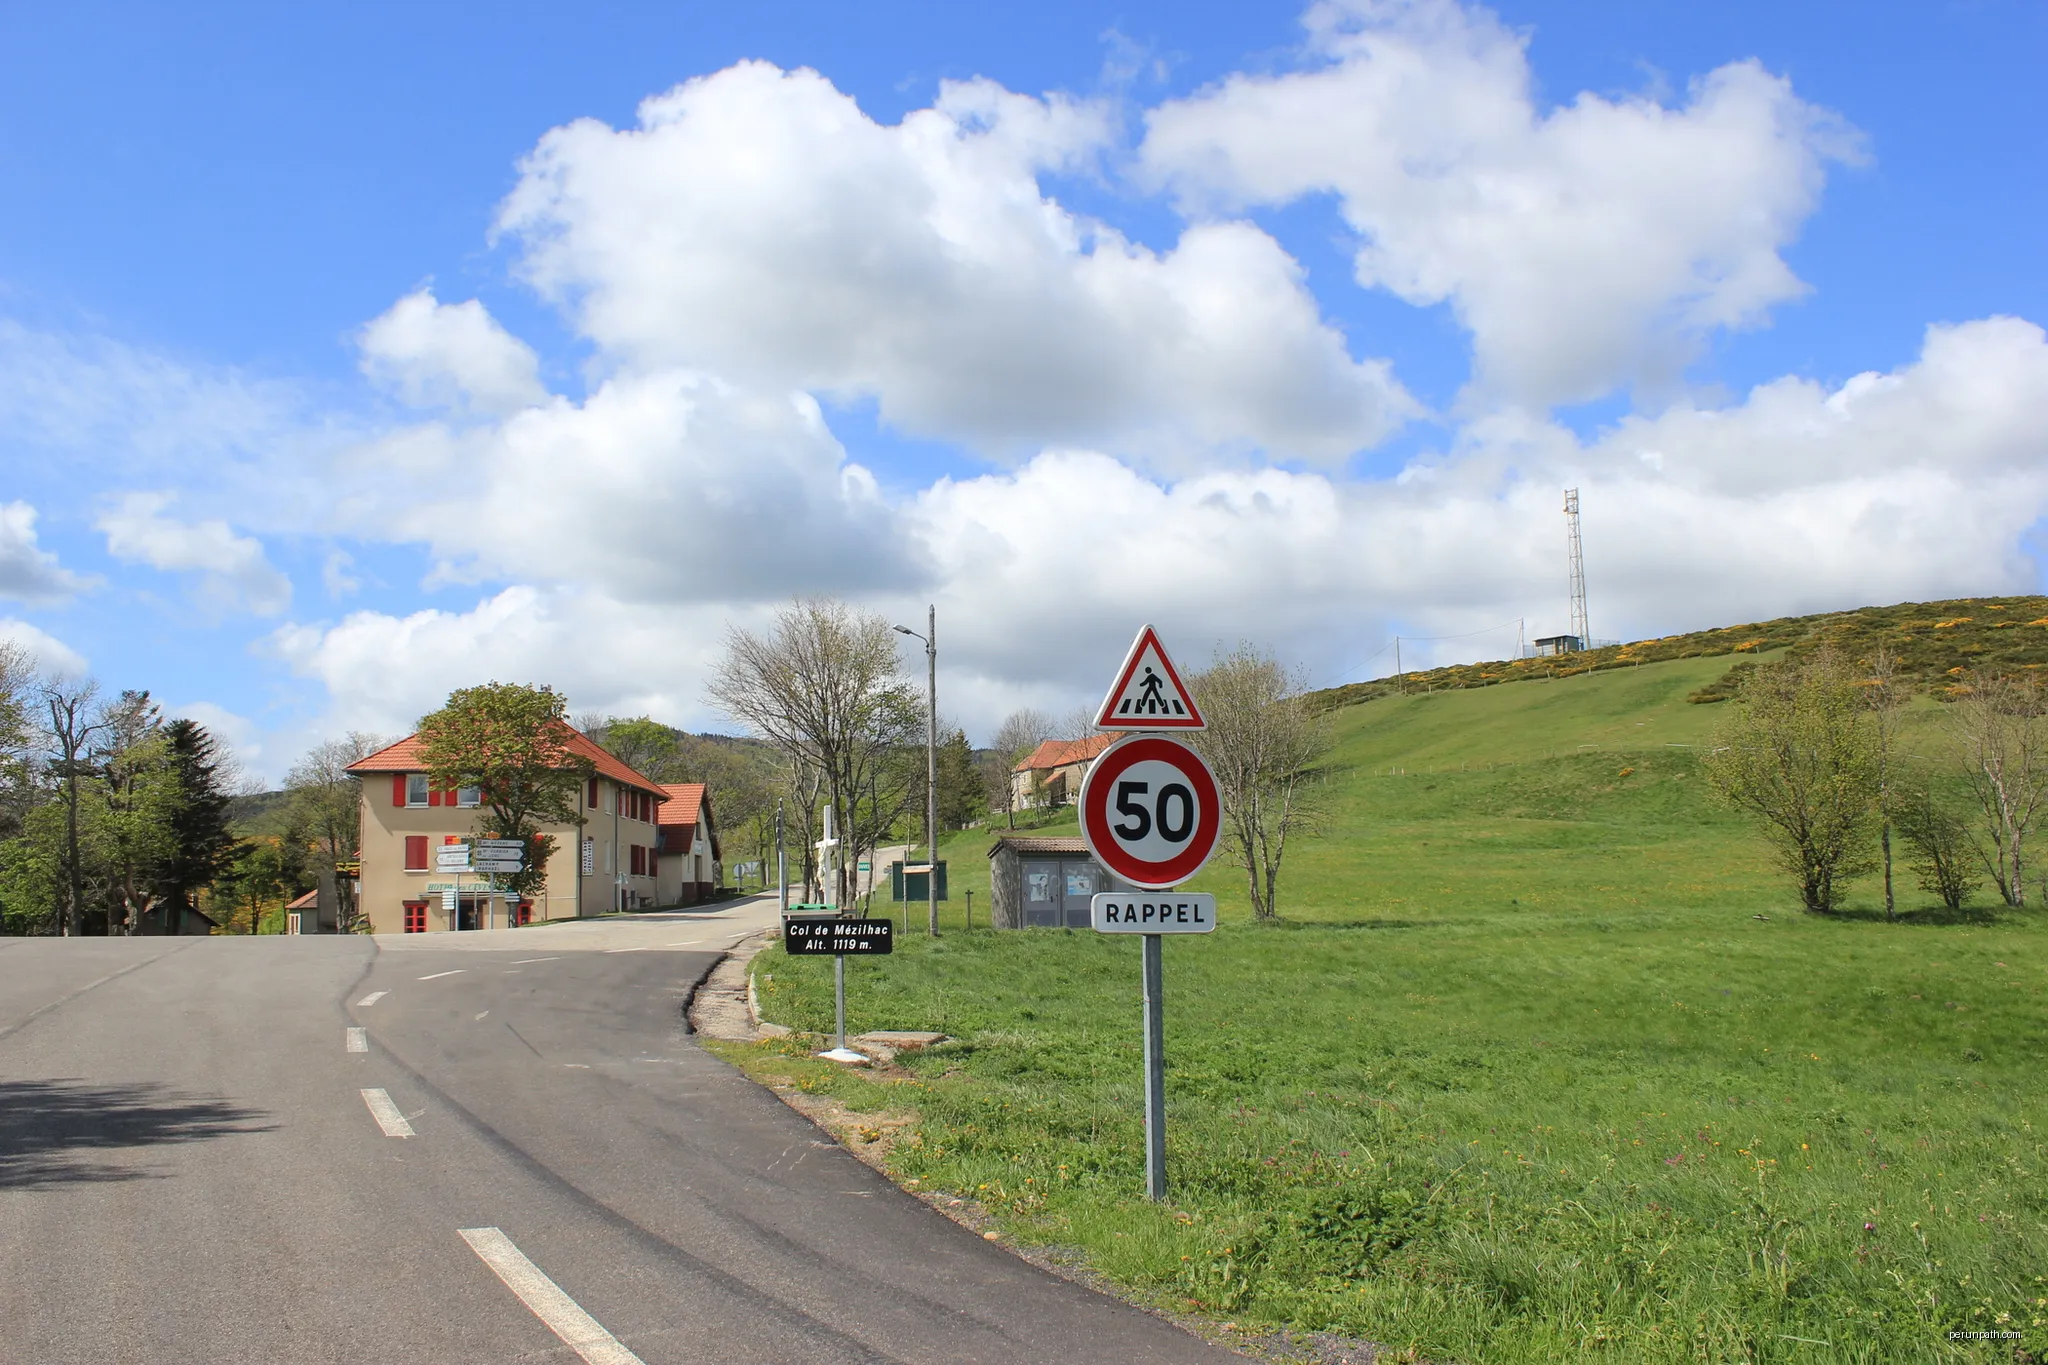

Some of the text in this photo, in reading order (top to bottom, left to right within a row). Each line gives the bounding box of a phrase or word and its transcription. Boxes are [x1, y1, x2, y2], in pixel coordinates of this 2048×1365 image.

[1113, 781, 1194, 843] 50
[1106, 903, 1205, 923] RAPPEL
[790, 924, 888, 936] Col de Mézilhac
[805, 939, 872, 950] Alt. 1119 m.
